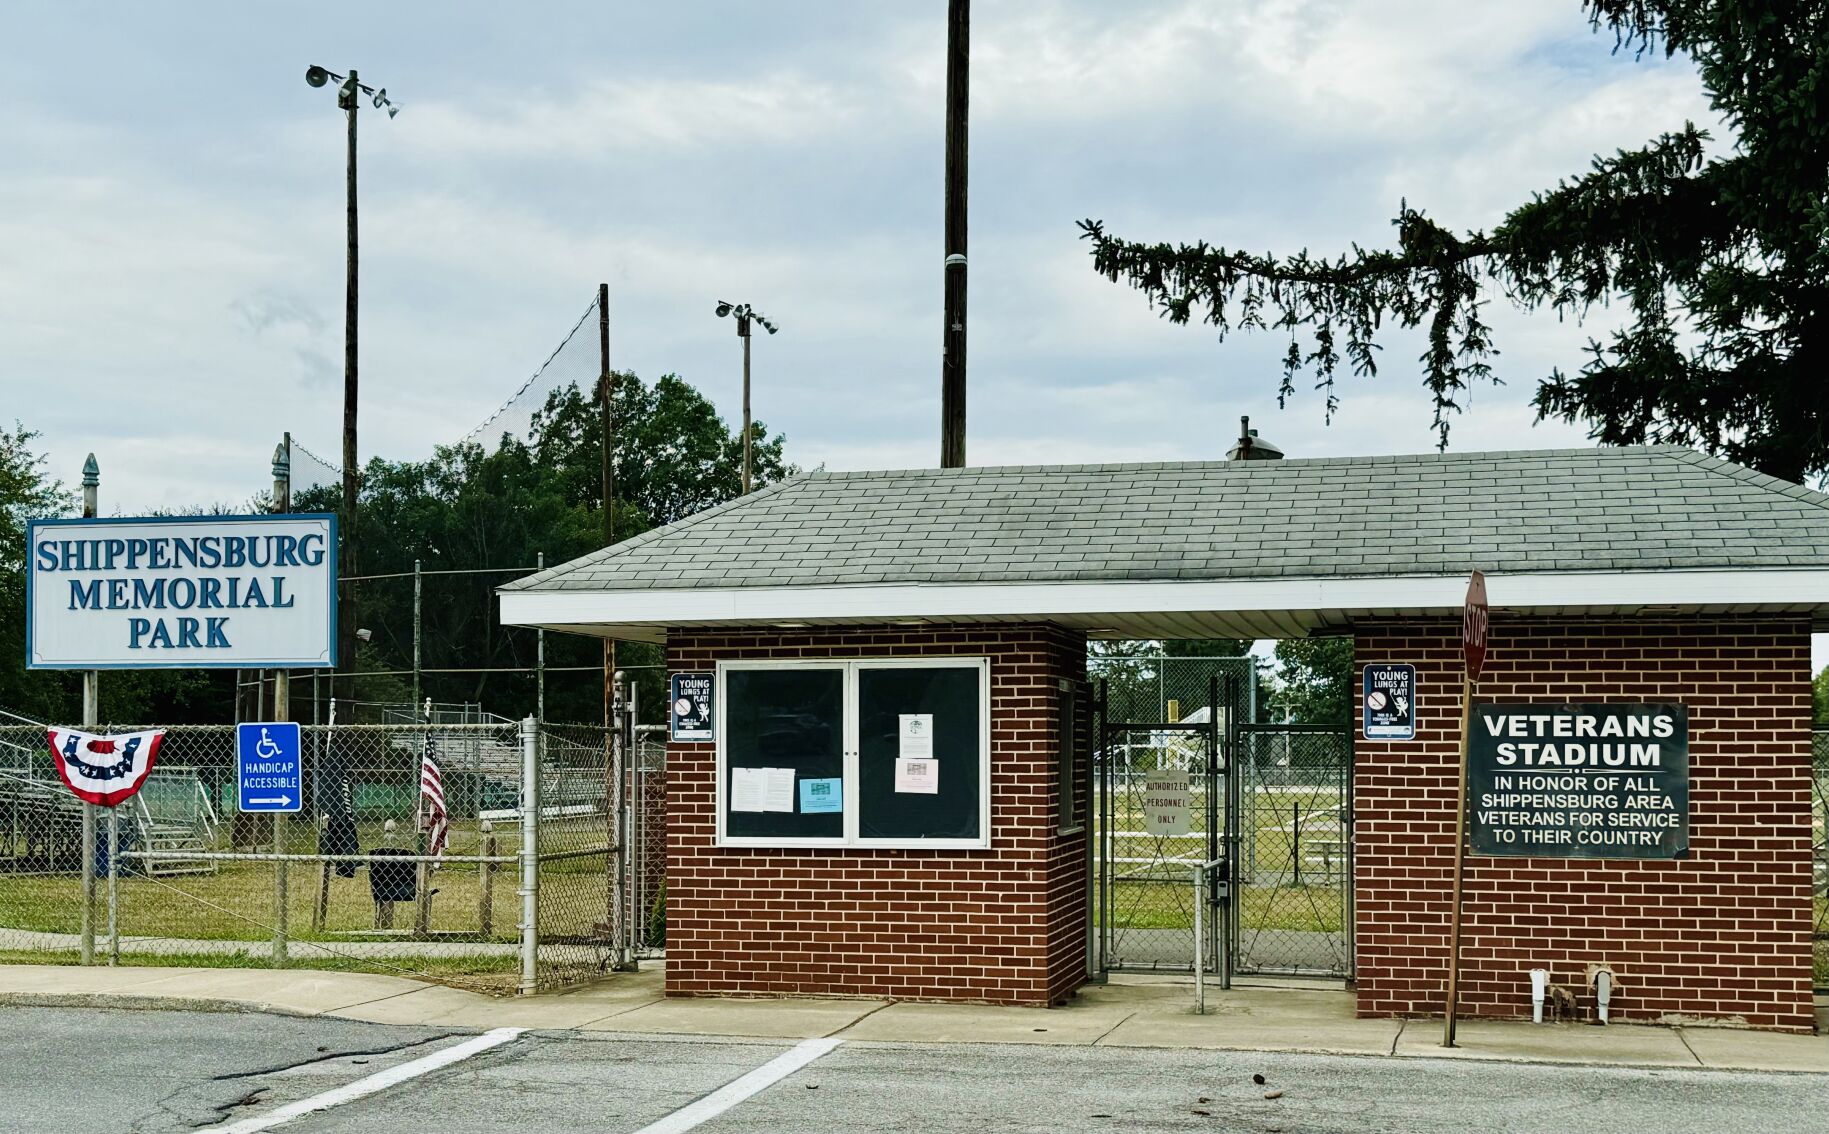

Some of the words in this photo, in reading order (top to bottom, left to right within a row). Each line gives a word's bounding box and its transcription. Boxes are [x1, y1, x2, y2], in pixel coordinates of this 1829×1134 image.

[37, 534, 326, 572] SHIPPENSBURG
[67, 576, 295, 610] MEMORIAL
[128, 616, 232, 649] PARK
[1465, 603, 1487, 648] STOP
[1373, 671, 1409, 680] YOUNG
[679, 680, 710, 689] YOUNG
[1483, 715, 1674, 738] VETERANS
[1496, 743, 1661, 766] STADIUM
[245, 762, 294, 774] HANDICAP
[243, 777, 297, 789] ACCESSIBLE
[1146, 782, 1188, 791] AUTHORIZED
[1494, 776, 1512, 790] IN
[1519, 776, 1588, 791] HONOR
[1594, 777, 1620, 791] OF
[1624, 777, 1661, 792] ALL
[1146, 798, 1187, 808] PERSONNEL
[1481, 793, 1619, 809] SHIPPENSBURG
[1625, 795, 1674, 810] AREA
[1157, 815, 1176, 824] ONLY
[1477, 811, 1566, 826] VETERANS
[1569, 812, 1604, 827] FOR
[1608, 812, 1680, 828] SERVICE
[1493, 829, 1516, 844] TO
[1521, 829, 1572, 844] THEIR
[1577, 830, 1664, 845] COUNTRY
